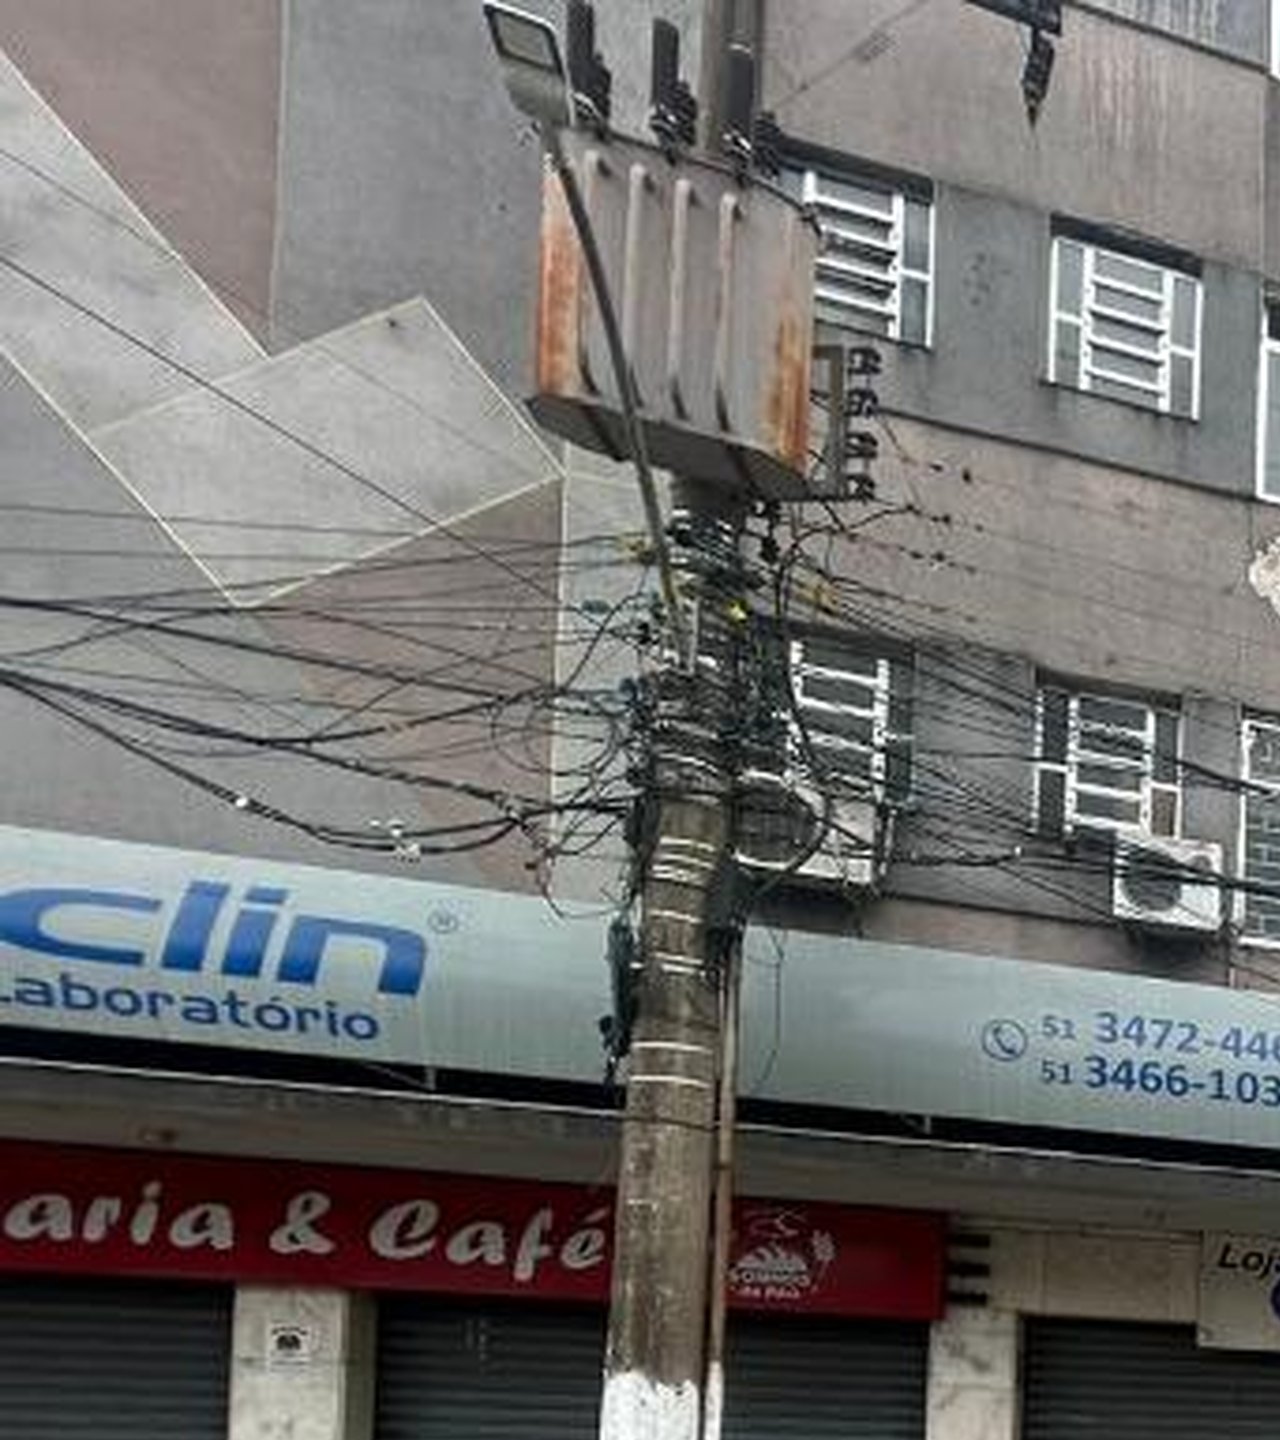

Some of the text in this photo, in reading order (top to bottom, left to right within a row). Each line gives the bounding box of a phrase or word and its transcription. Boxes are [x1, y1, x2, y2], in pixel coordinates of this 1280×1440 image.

[0, 971, 379, 1041] aboratório
[1041, 1015, 1076, 1040] 51
[1041, 1060, 1075, 1085] 51
[268, 1191, 335, 1255] &
[368, 1198, 610, 1281] Café
